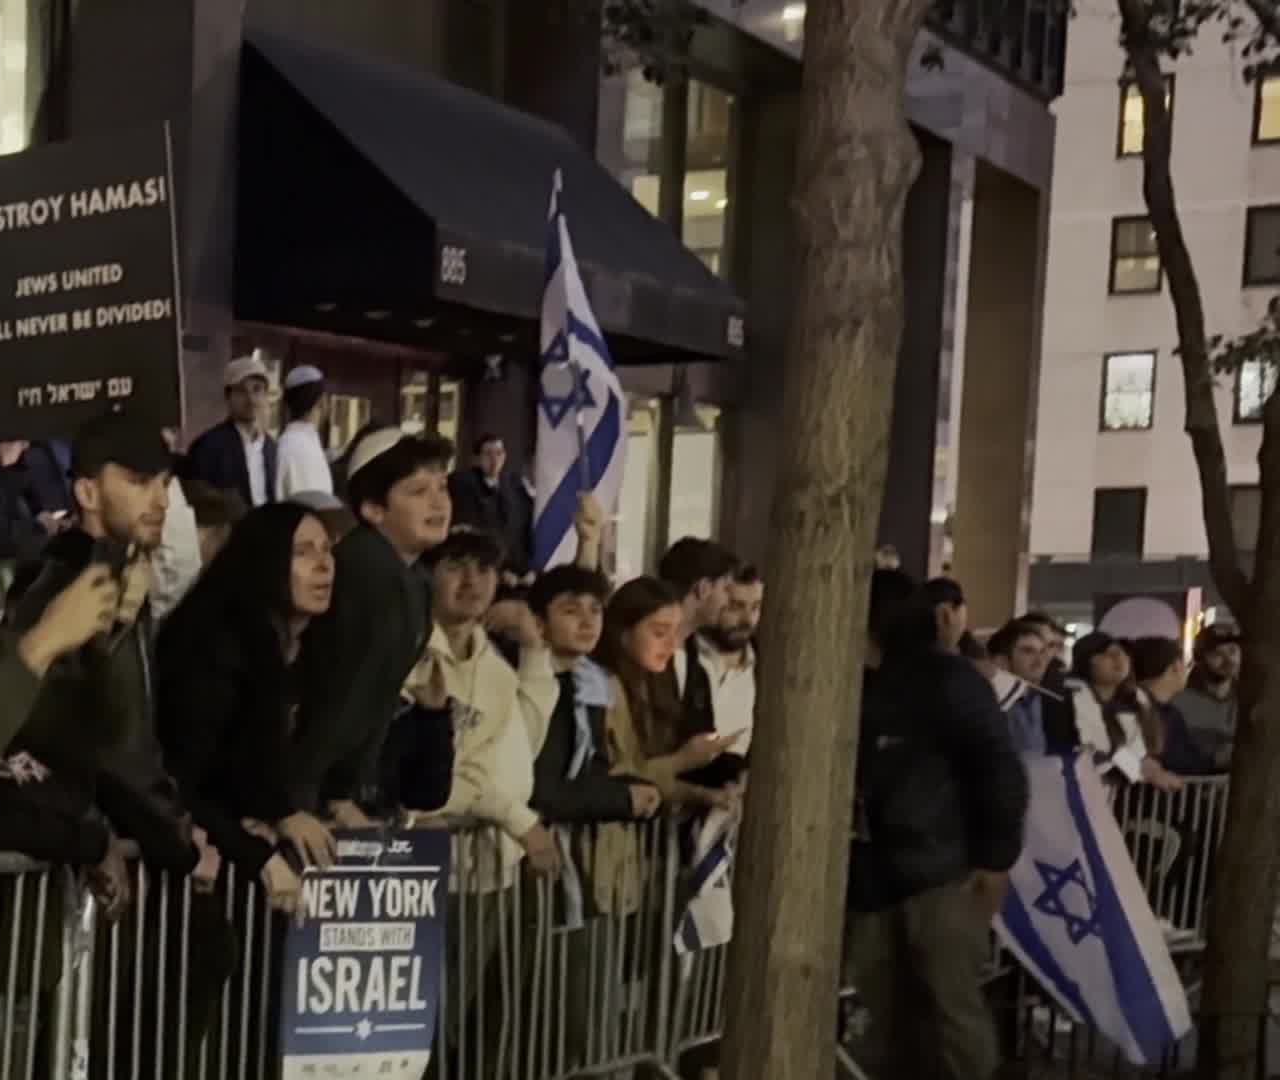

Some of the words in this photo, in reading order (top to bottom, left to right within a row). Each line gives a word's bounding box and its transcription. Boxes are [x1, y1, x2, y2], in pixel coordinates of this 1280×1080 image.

[70, 175, 166, 218] HAMAS!
[15, 274, 58, 298] JEWS
[61, 263, 123, 292] UNITED
[16, 313, 68, 339] NEVER
[72, 308, 92, 331] BE
[302, 878, 360, 919] NEW
[367, 878, 439, 919] YORK
[322, 926, 376, 947] STANDS
[295, 955, 428, 1015] ISRAEL
